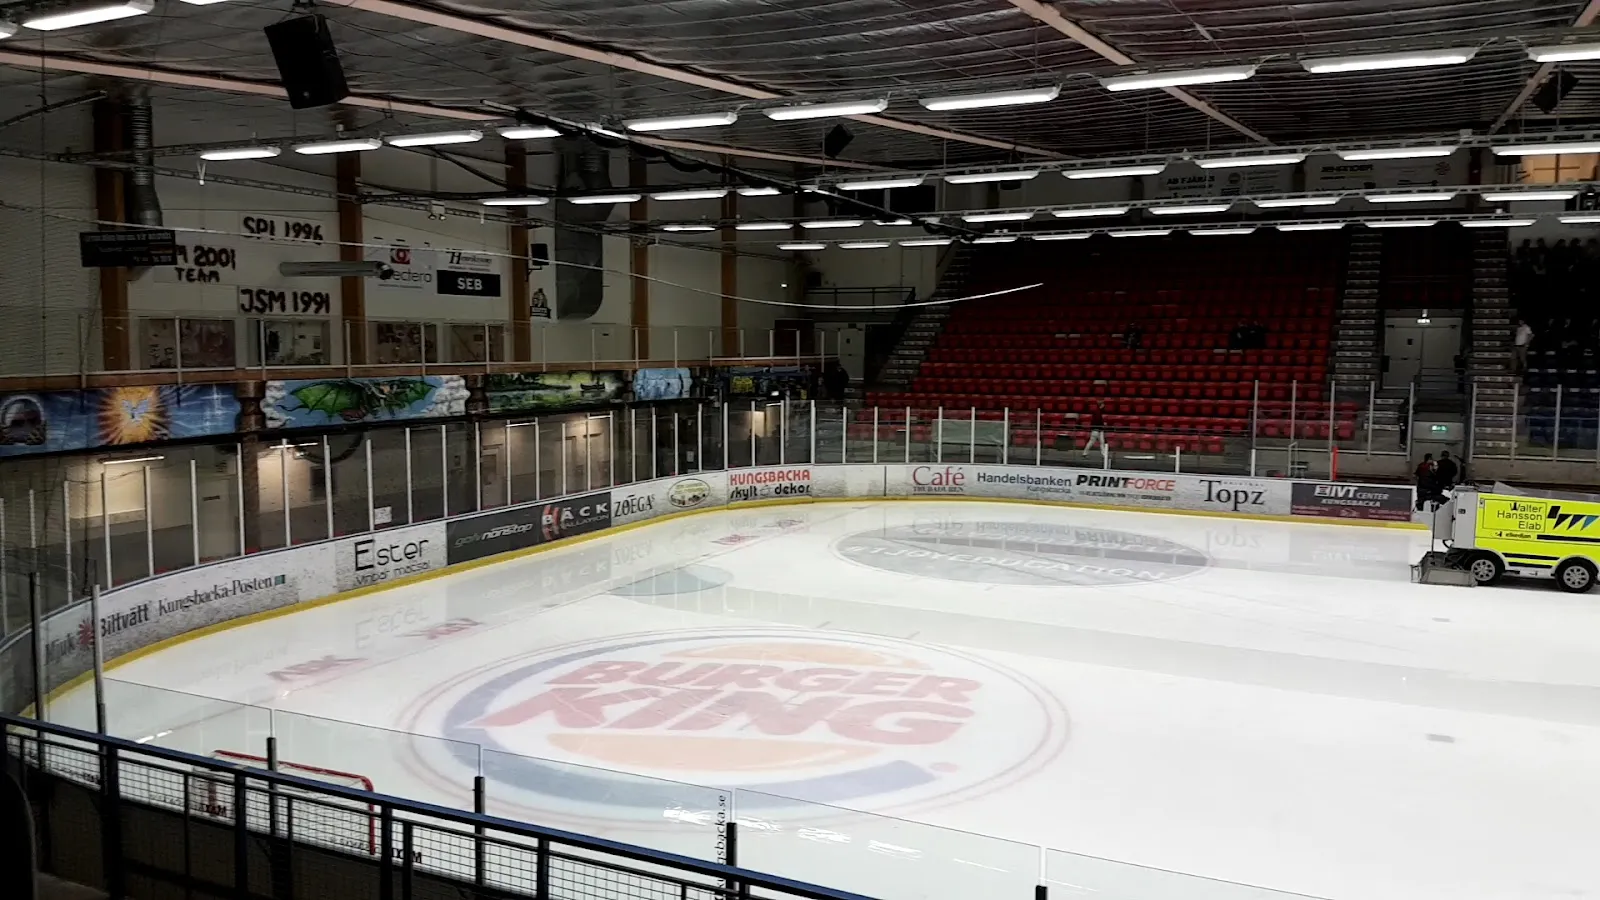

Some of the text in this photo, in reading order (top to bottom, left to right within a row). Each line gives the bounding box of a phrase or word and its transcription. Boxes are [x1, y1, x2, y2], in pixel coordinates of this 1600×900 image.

[284, 221, 324, 245] 1996
[194, 245, 236, 270] 2001
[175, 267, 220, 282] TEAM
[456, 277, 484, 291] SEB
[240, 288, 331, 314] JSM 1991
[730, 469, 811, 486] KUNGSBACKA
[912, 465, 965, 487] Café
[976, 472, 1072, 487] Handelsbanken
[1075, 474, 1176, 492] PRINTFORCE
[730, 482, 811, 501] skylt dekor
[1199, 479, 1266, 512] Topz
[1330, 485, 1390, 501] IVT CENTER
[1320, 499, 1381, 508] KUNGSBACKA
[1509, 502, 1543, 513] Walter
[1496, 510, 1543, 521] Hansson
[1518, 521, 1542, 531] Elab
[354, 538, 430, 572] Ester
[545, 660, 984, 703] BURGER
[470, 687, 976, 746] KING
